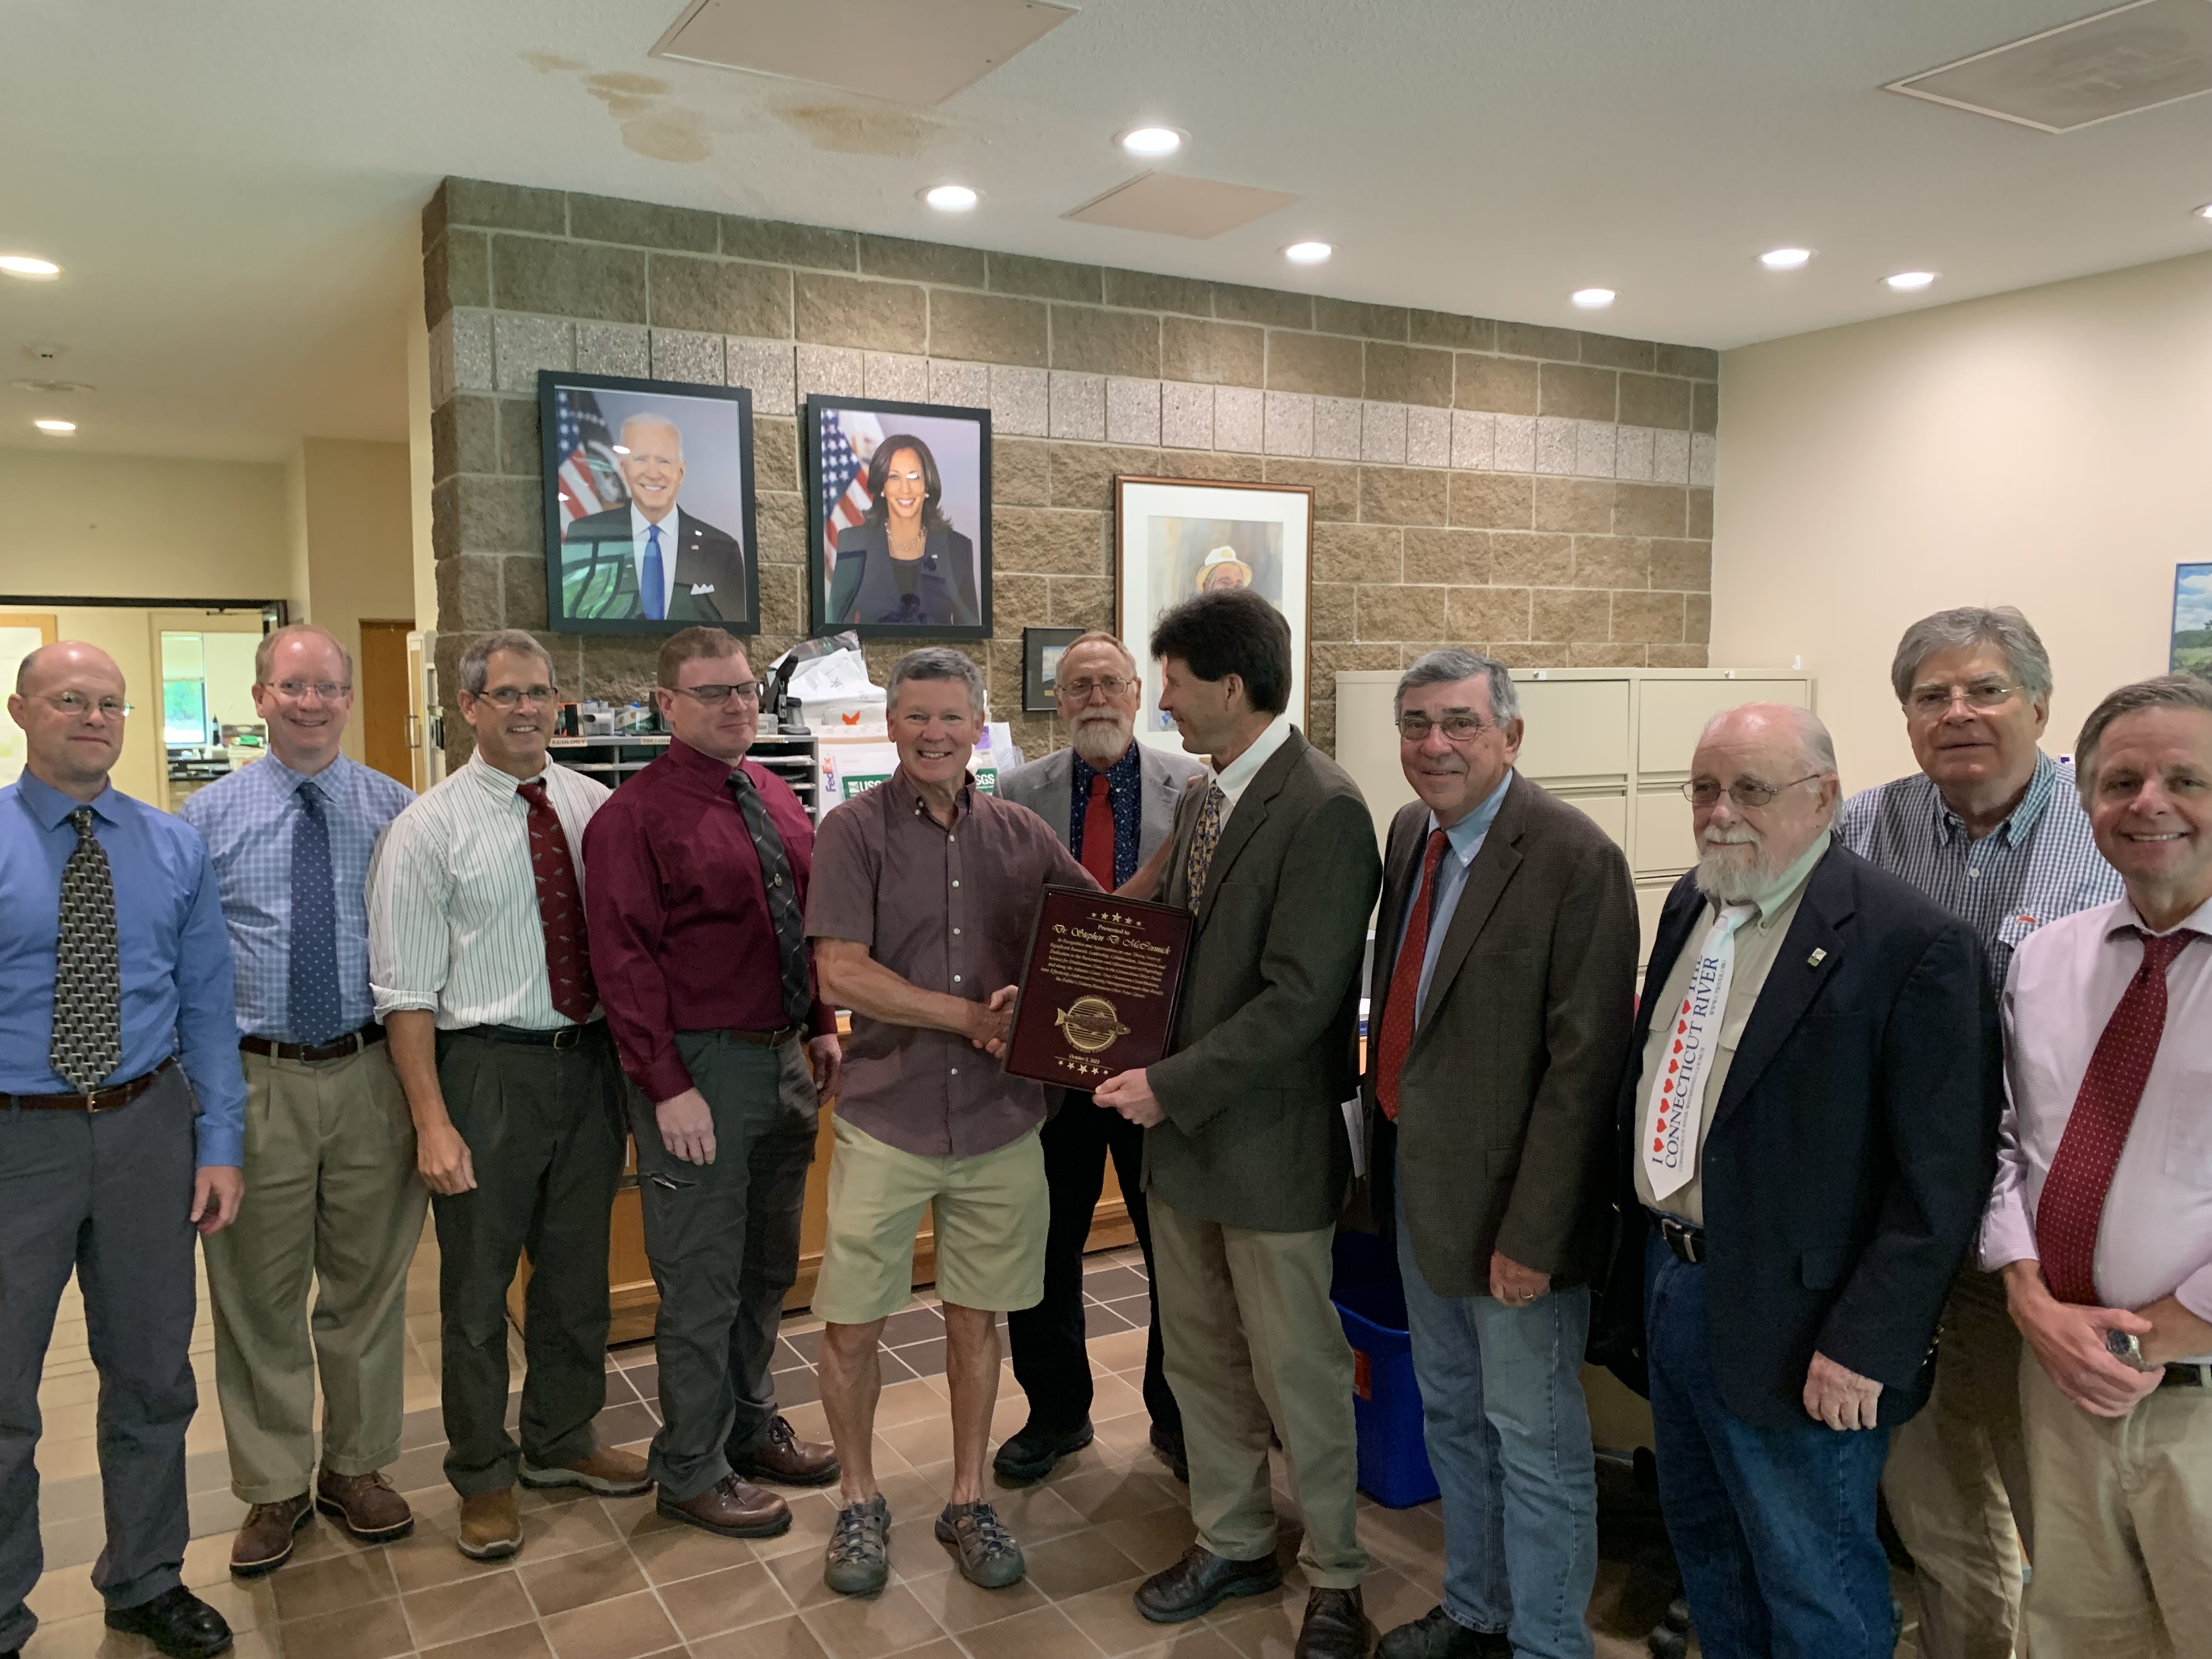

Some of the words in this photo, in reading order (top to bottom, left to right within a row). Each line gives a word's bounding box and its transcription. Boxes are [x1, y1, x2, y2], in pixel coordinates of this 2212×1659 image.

[822, 758, 836, 792] FedEx
[975, 774, 995, 786] SGS
[1071, 927, 1104, 941] Stephen
[1098, 924, 1124, 934] Presented
[1665, 1021, 1702, 1169] CONNECTICUT
[1693, 957, 1719, 1018] RIVER
[1652, 1155, 1663, 1165] I
